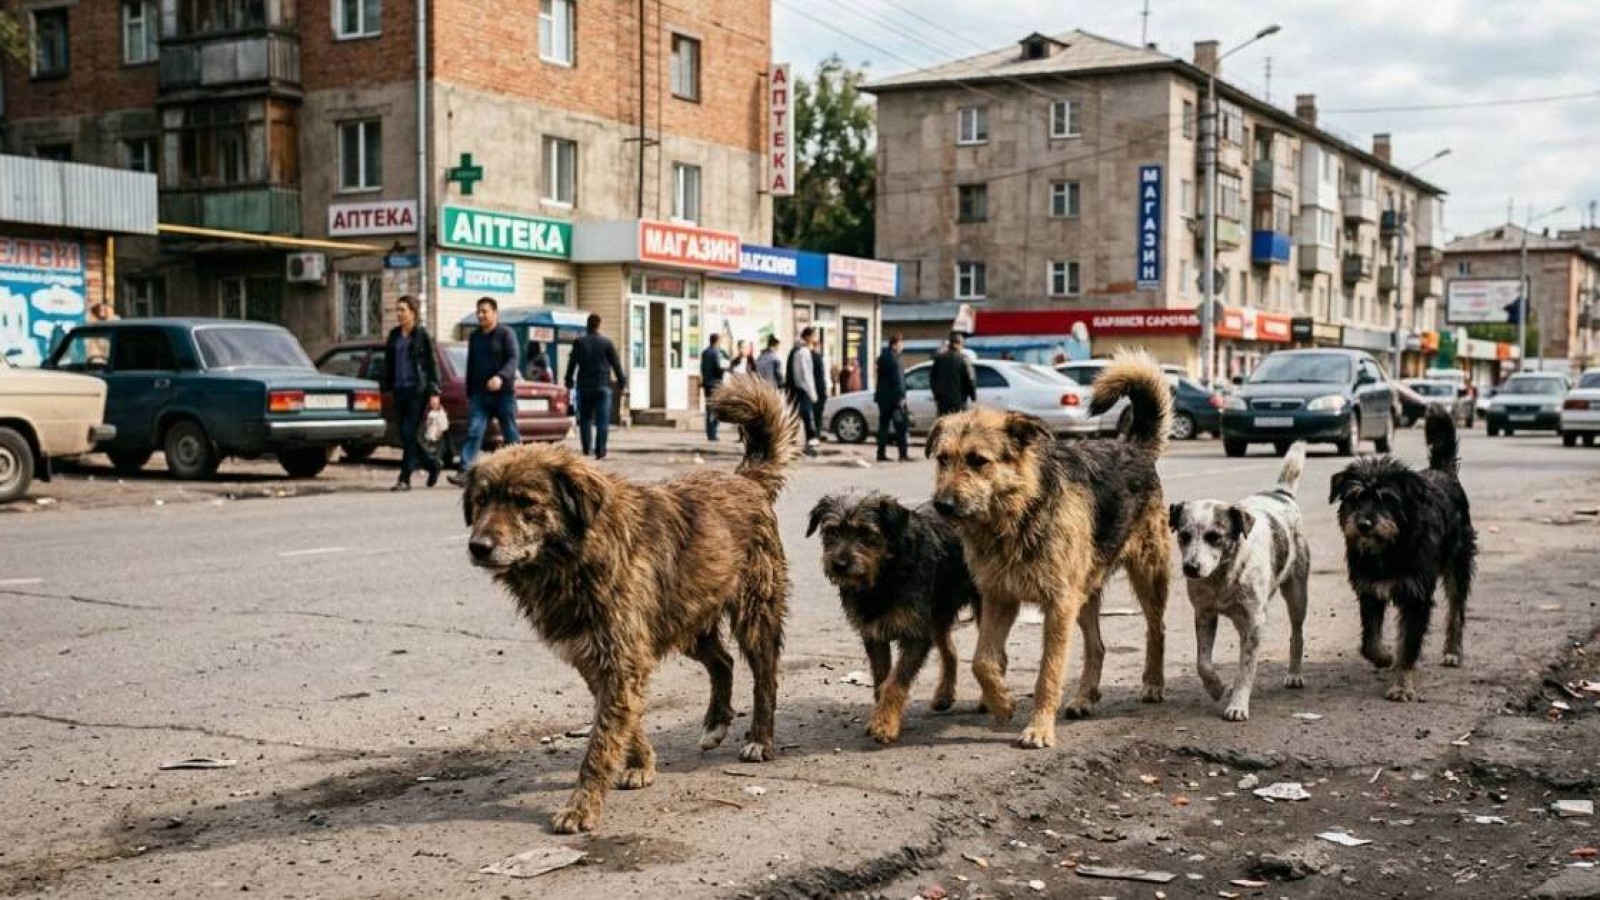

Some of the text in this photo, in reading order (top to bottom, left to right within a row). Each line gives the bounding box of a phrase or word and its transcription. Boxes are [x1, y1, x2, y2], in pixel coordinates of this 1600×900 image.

[772, 68, 787, 191] АПТЕКА
[333, 206, 413, 230] АПТЕКА
[452, 212, 565, 254] АПТЕКА
[1142, 169, 1158, 279] МАГАЗИН
[644, 227, 737, 266] МАГАЗИН
